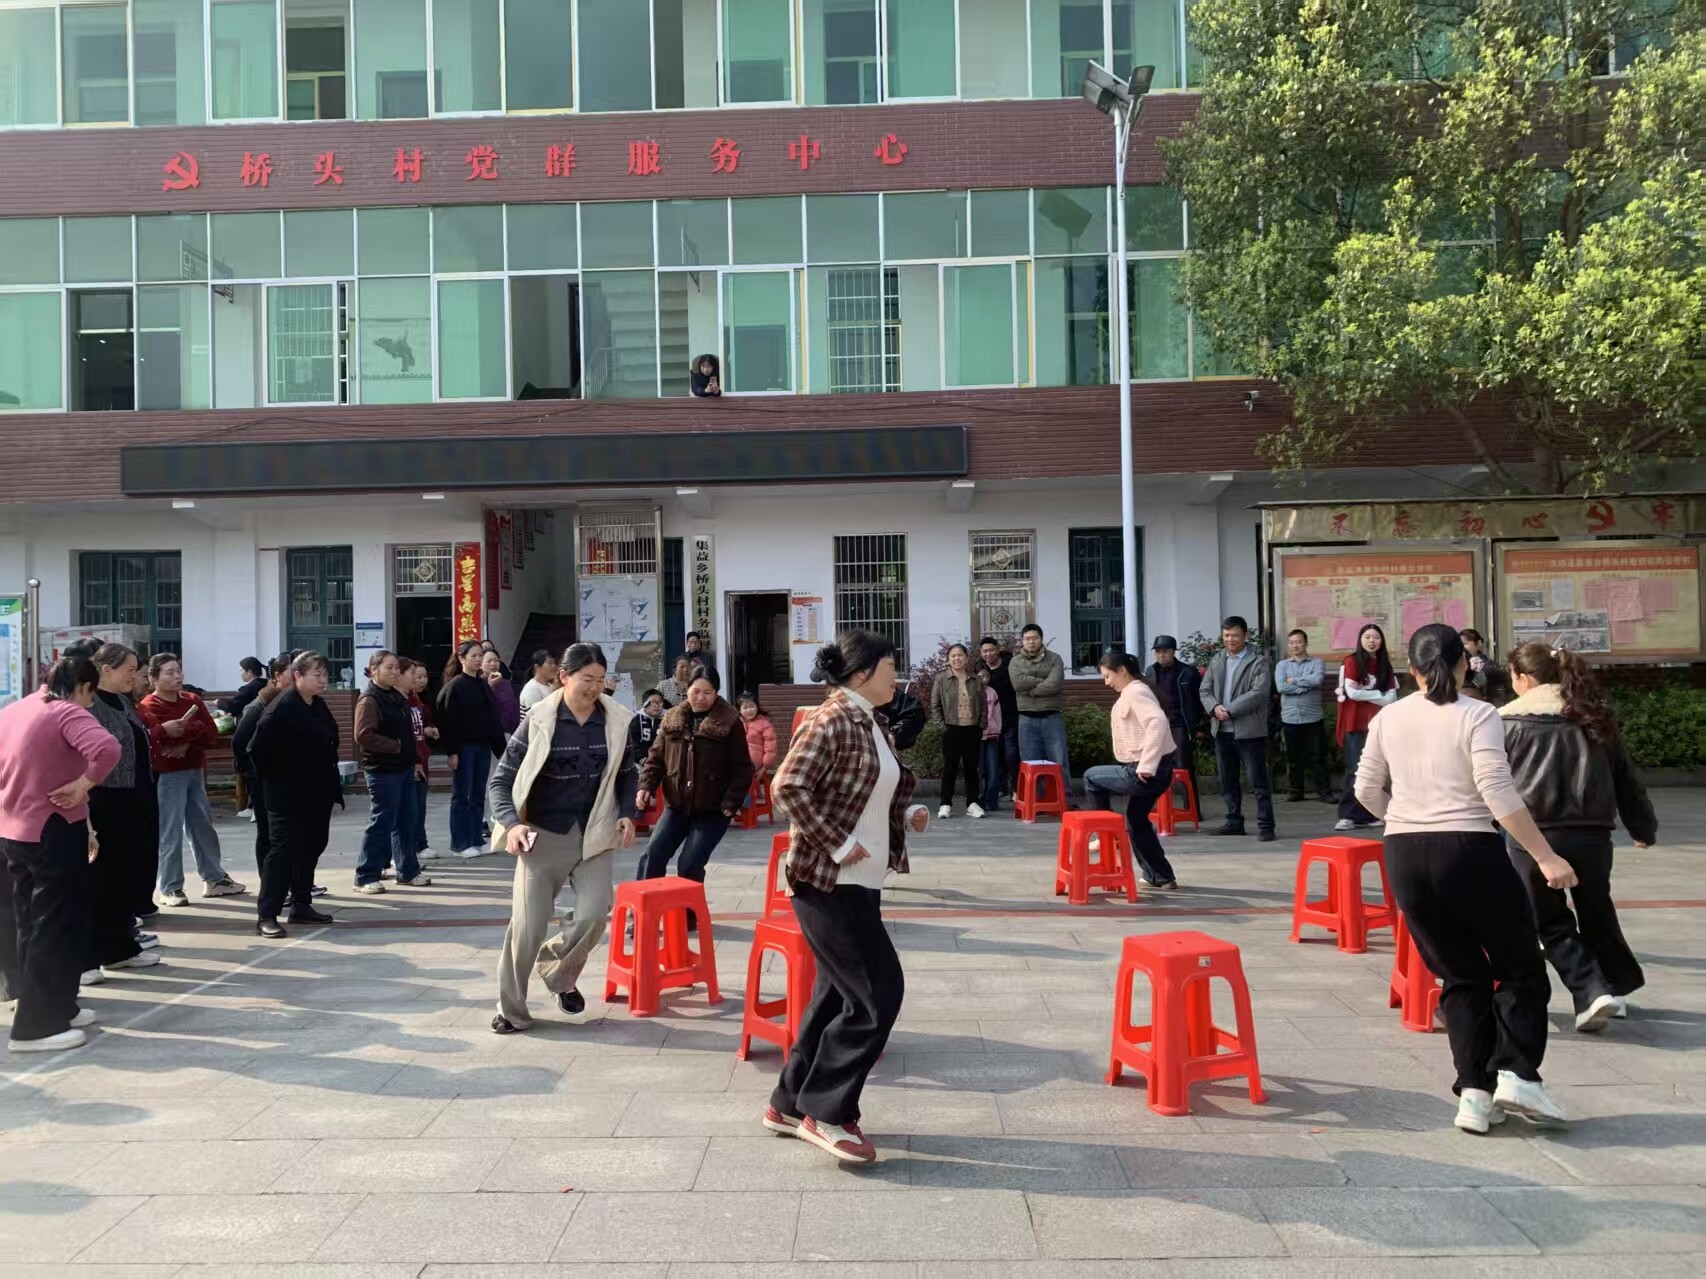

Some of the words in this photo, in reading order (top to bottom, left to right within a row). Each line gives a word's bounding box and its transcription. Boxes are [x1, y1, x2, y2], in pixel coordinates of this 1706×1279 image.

[240, 133, 908, 188] 桥头村党群服务中心
[1331, 509, 1549, 536] 不忘初心
